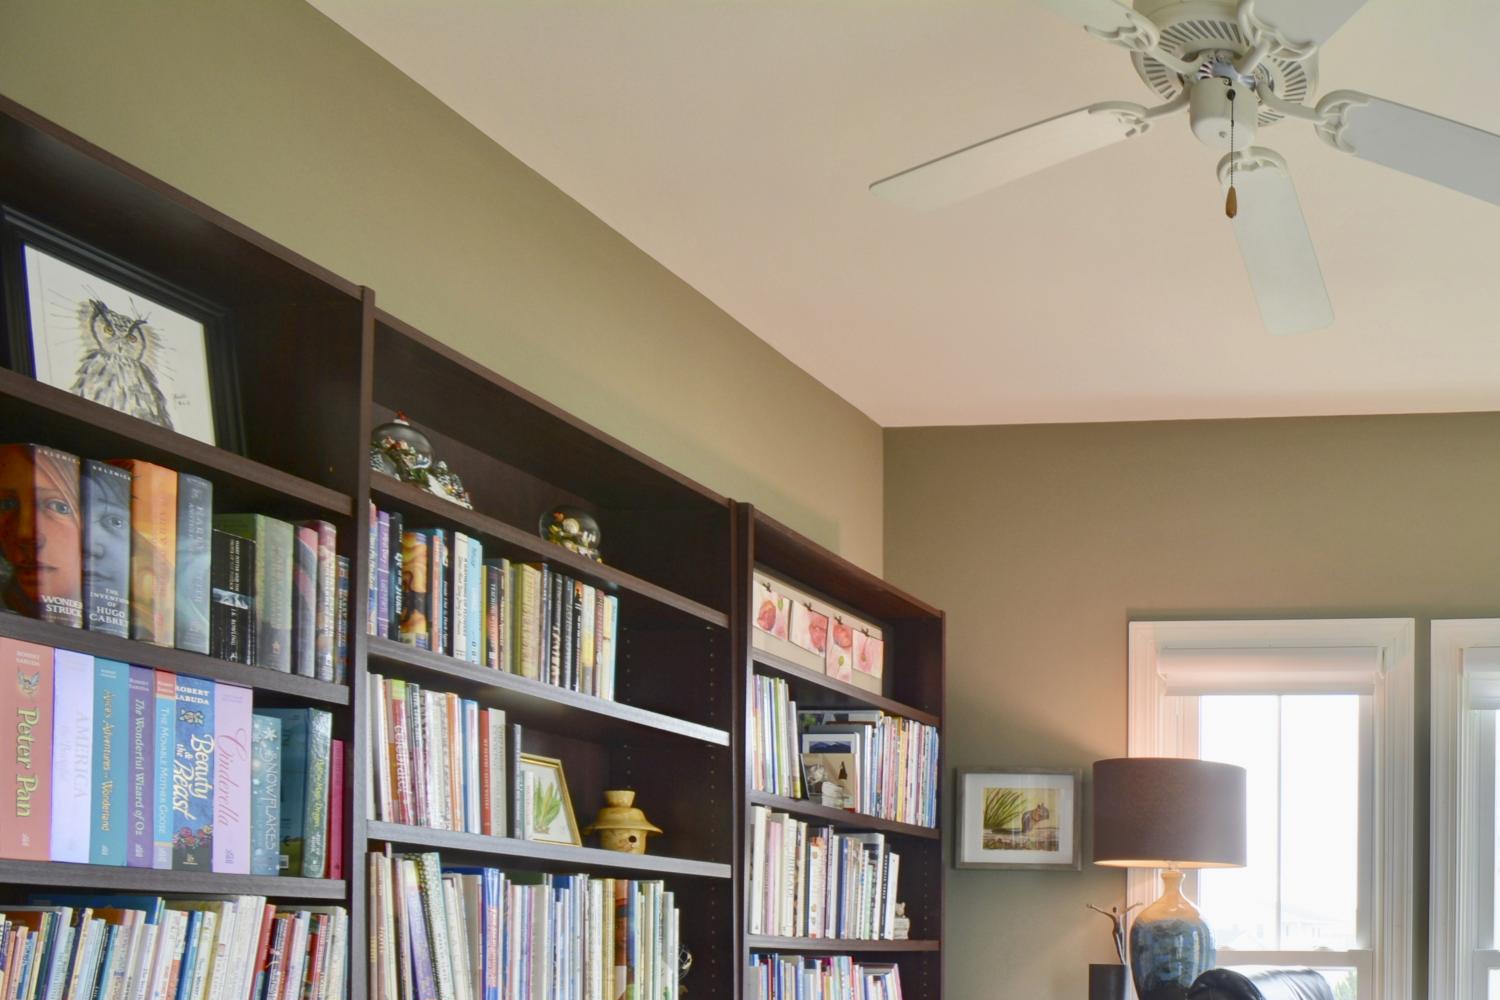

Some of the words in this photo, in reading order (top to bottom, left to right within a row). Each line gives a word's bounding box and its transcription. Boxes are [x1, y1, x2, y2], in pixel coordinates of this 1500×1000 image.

[97, 607, 125, 618] HUGO
[135, 699, 145, 716] The
[16, 707, 40, 770] Peter
[135, 717, 145, 770] Wonderful
[160, 726, 170, 765] MOVABLE
[394, 725, 412, 794] celebrate!
[159, 767, 169, 803] MOTHER
[173, 760, 196, 821] Beast
[191, 734, 217, 799] Beauty
[218, 728, 247, 826] Cinderella
[16, 773, 40, 818] Pan
[101, 781, 113, 832] Wonderland
[135, 773, 144, 809] Wizard
[260, 748, 280, 850] SNOWFLAKES
[133, 810, 144, 821] of
[135, 821, 144, 836] Oz
